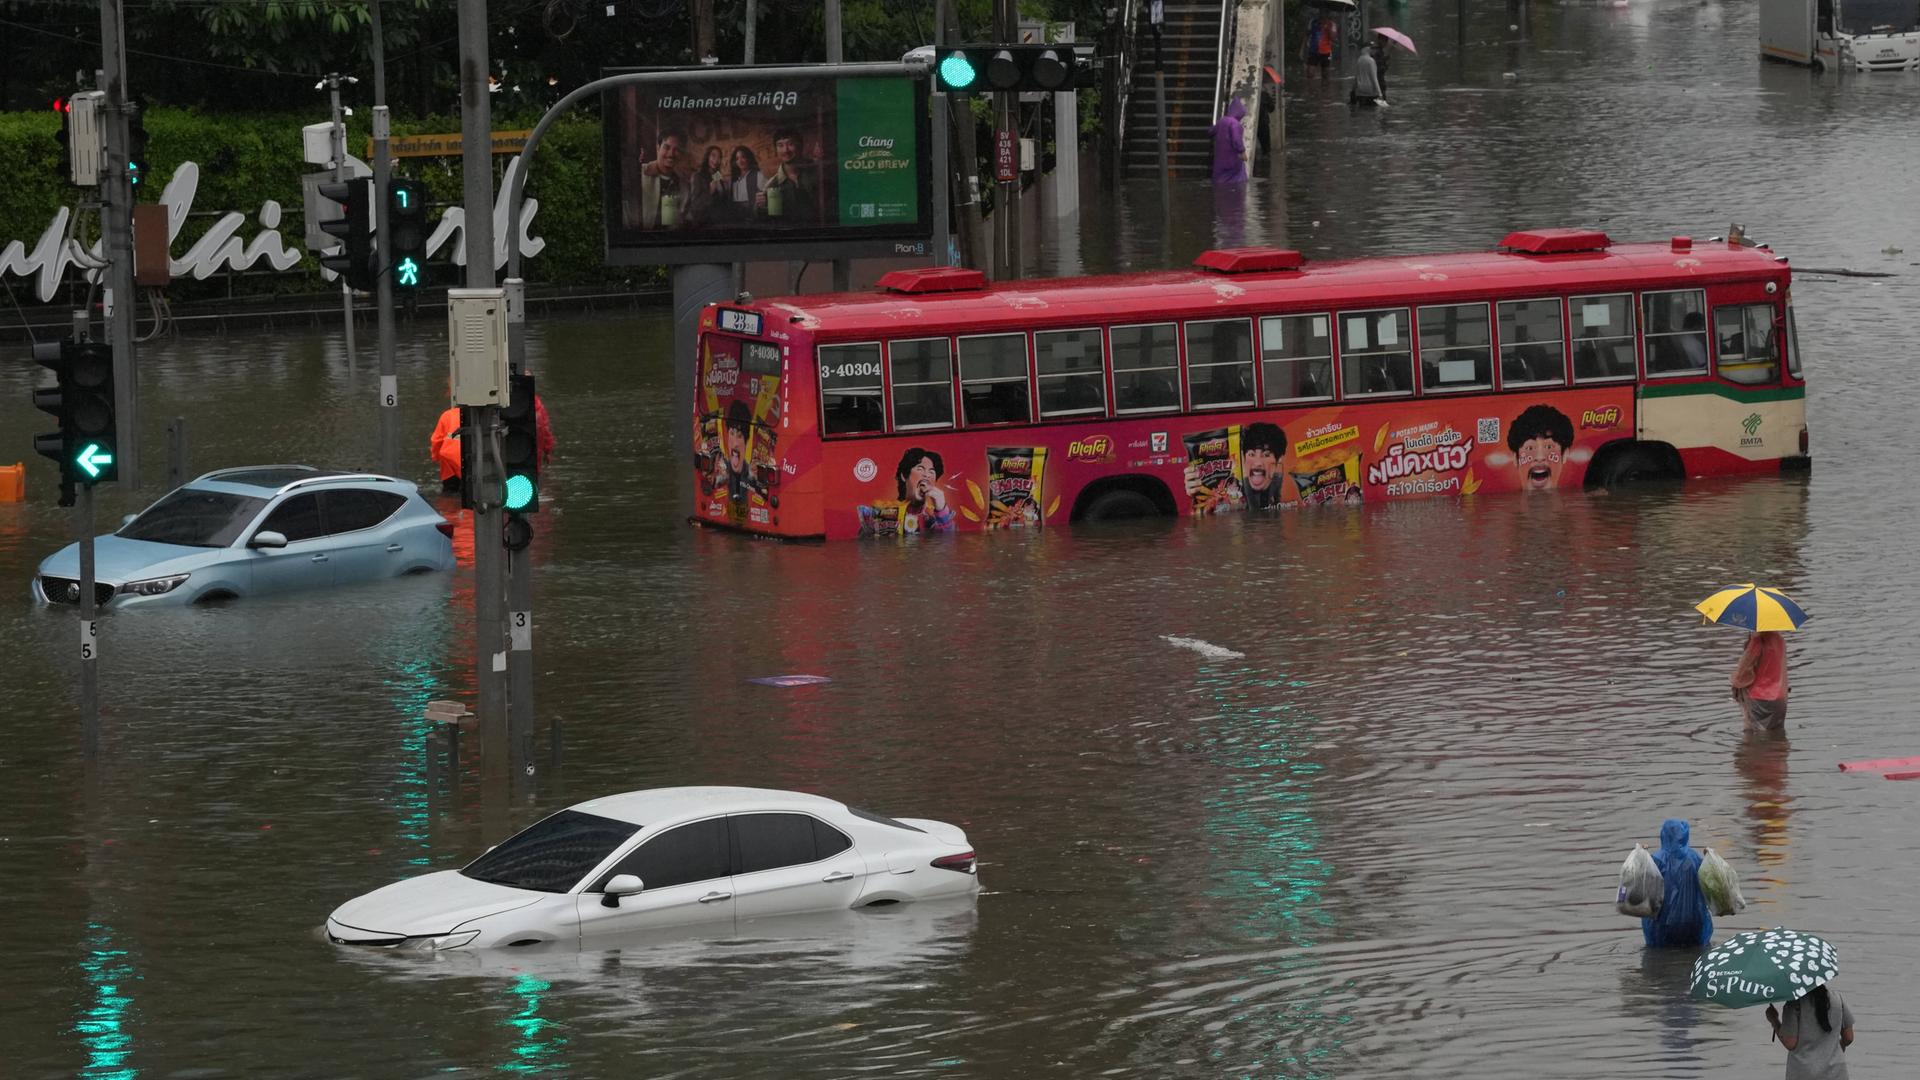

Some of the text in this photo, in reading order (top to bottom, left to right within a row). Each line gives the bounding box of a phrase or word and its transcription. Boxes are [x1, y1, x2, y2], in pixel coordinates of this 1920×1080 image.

[859, 136, 894, 149] Chang
[844, 160, 909, 170] COLD BREW
[895, 243, 924, 253] Plan-B
[750, 344, 779, 361] 3-40304
[821, 362, 881, 378] 3-40304
[386, 394, 394, 406] 6
[1396, 426, 1418, 438] POTATO
[1740, 437, 1763, 445] BMTA
[515, 612, 526, 628] 3
[90, 621, 97, 637] 5
[82, 643, 92, 659] 5
